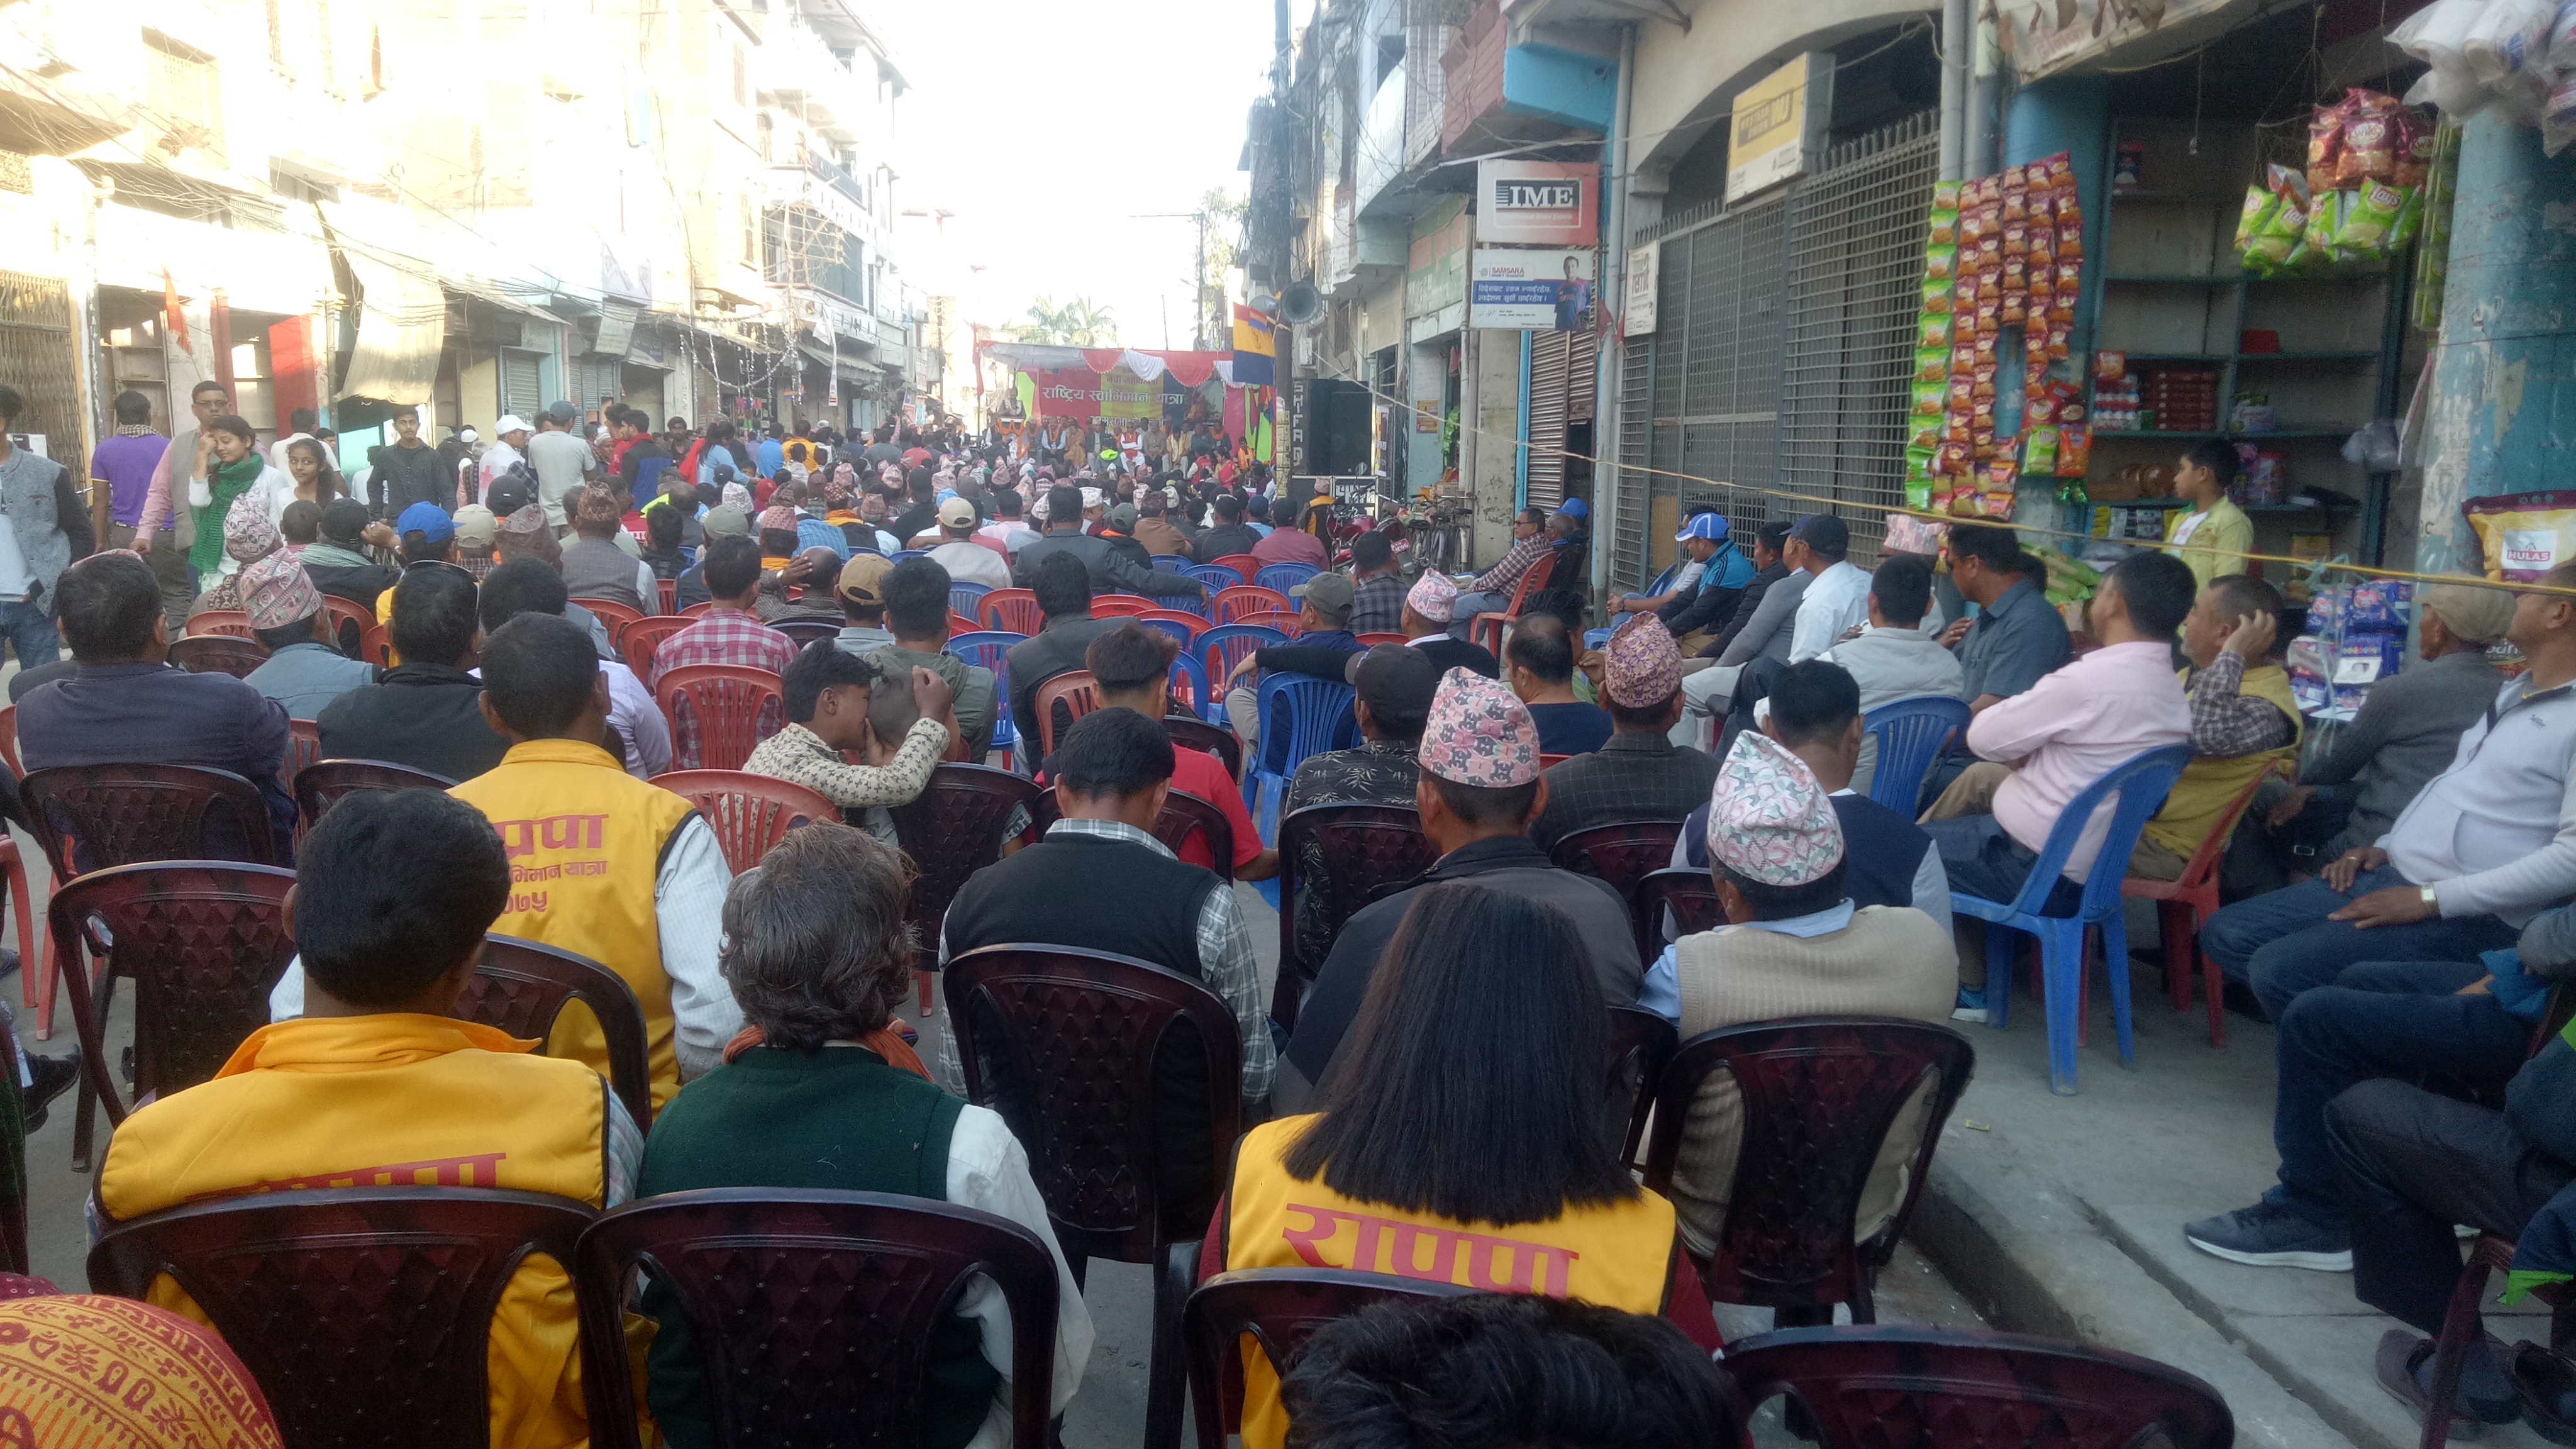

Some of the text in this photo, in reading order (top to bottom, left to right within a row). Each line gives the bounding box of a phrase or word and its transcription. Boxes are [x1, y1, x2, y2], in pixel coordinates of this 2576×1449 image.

[1509, 186, 1574, 208] IME
[1089, 388, 1149, 403] स्वाभिमान
[1153, 393, 1185, 404] यात्रा
[2508, 550, 2549, 560] HULAS
[564, 860, 608, 876] यात्रा
